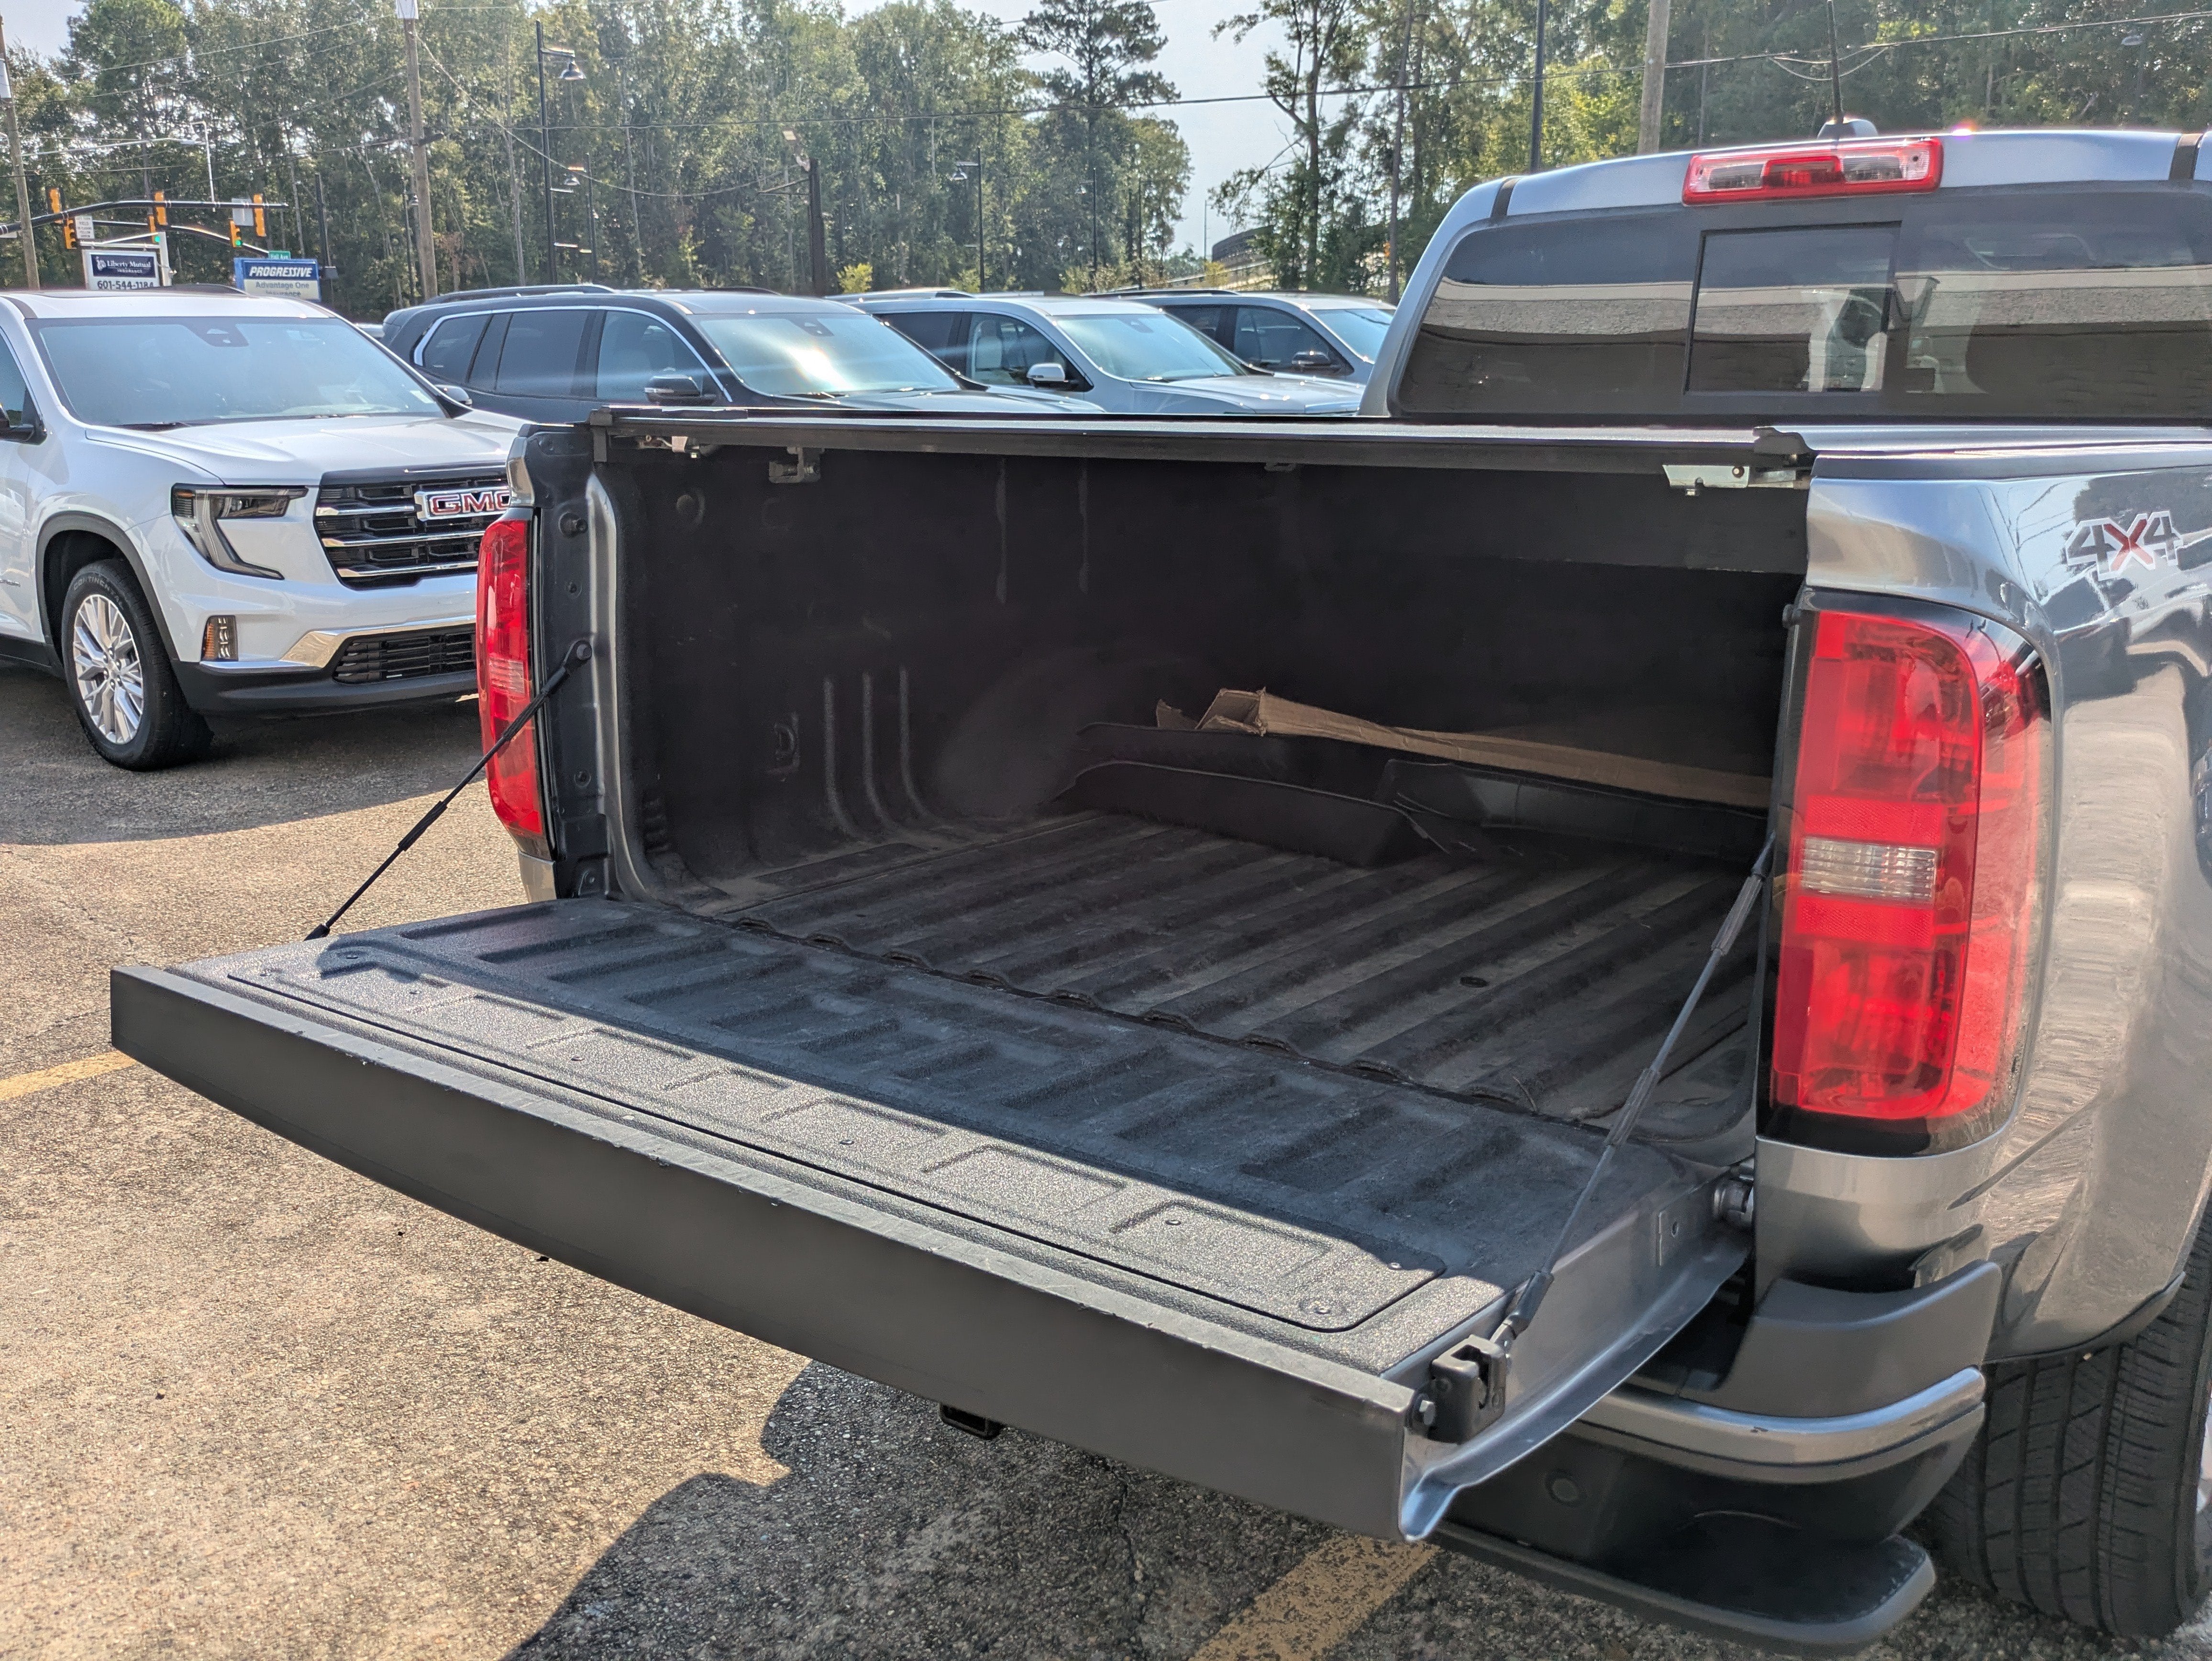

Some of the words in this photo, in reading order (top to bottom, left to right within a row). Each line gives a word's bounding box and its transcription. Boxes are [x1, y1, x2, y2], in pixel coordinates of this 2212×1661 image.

[107, 260, 128, 269] Liberty
[249, 266, 313, 277] PROGRESSIVE
[255, 281, 293, 290] Advantage
